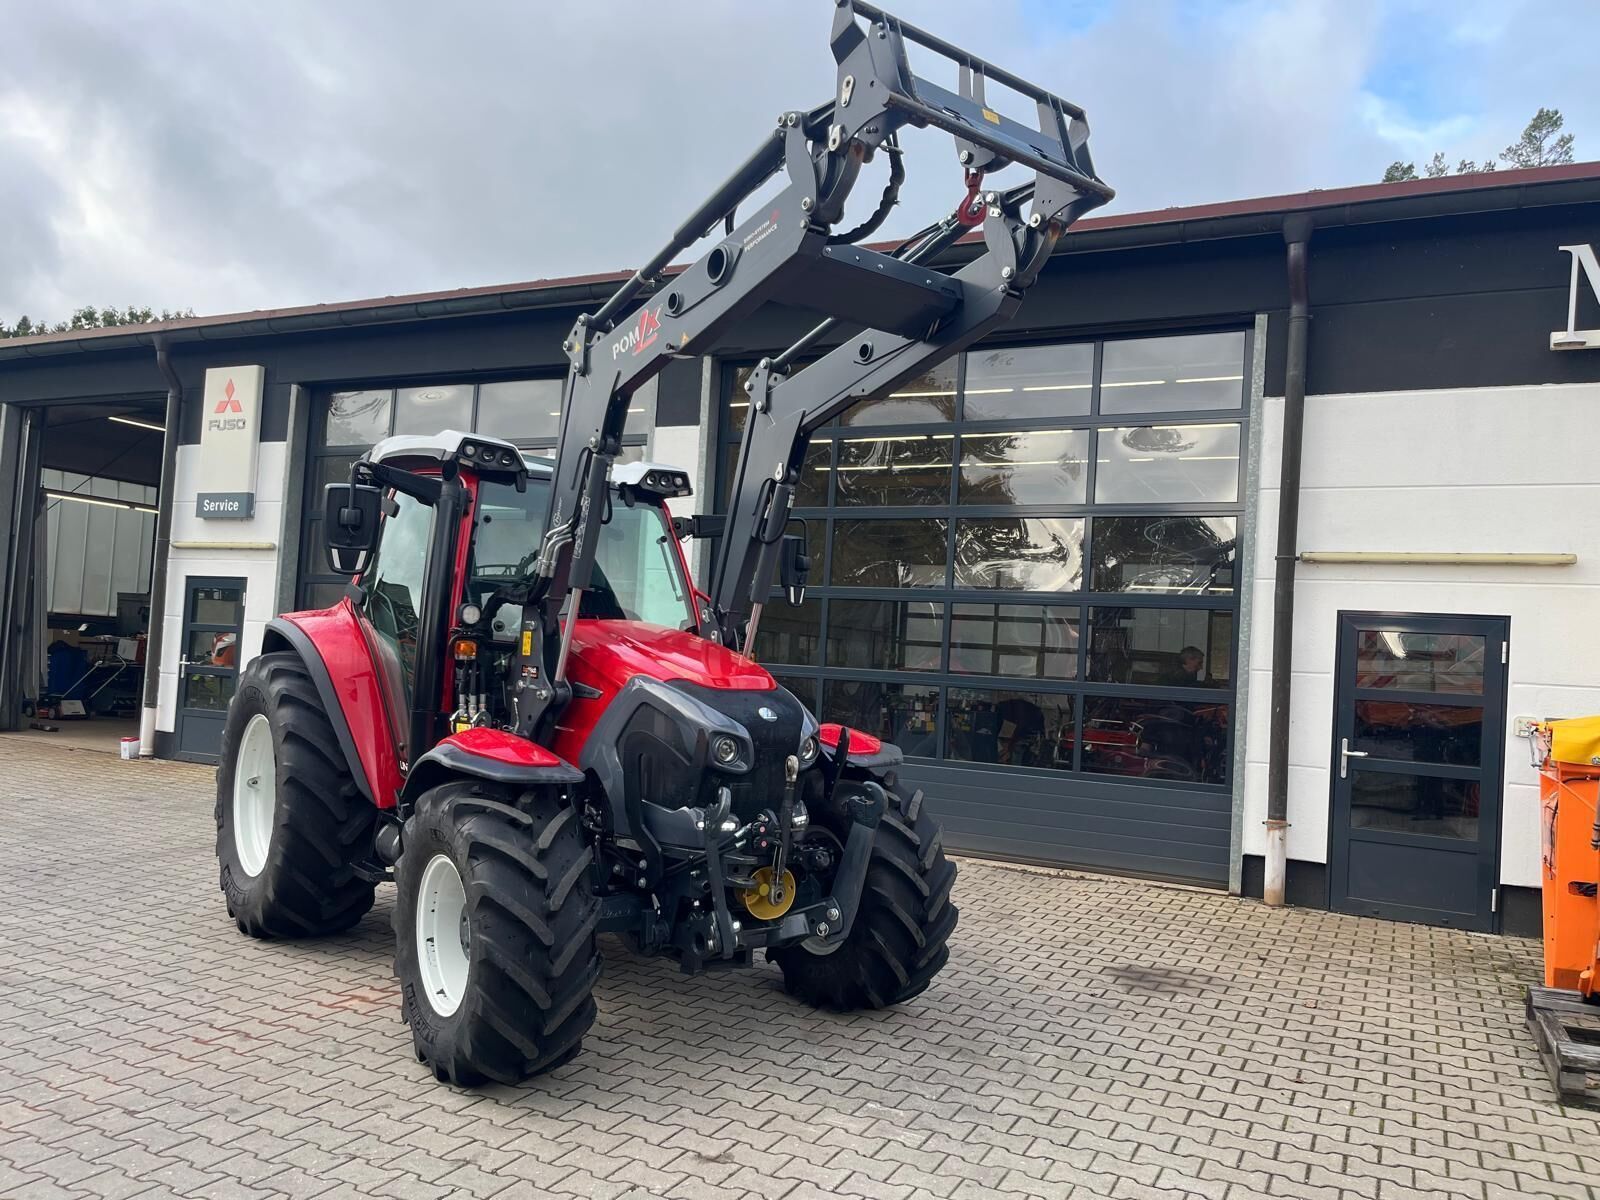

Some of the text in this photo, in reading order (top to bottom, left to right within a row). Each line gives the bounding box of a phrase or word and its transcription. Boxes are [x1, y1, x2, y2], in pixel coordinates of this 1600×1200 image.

[612, 325, 640, 360] POM
[208, 418, 246, 431] FUSO
[203, 498, 239, 511] Service
